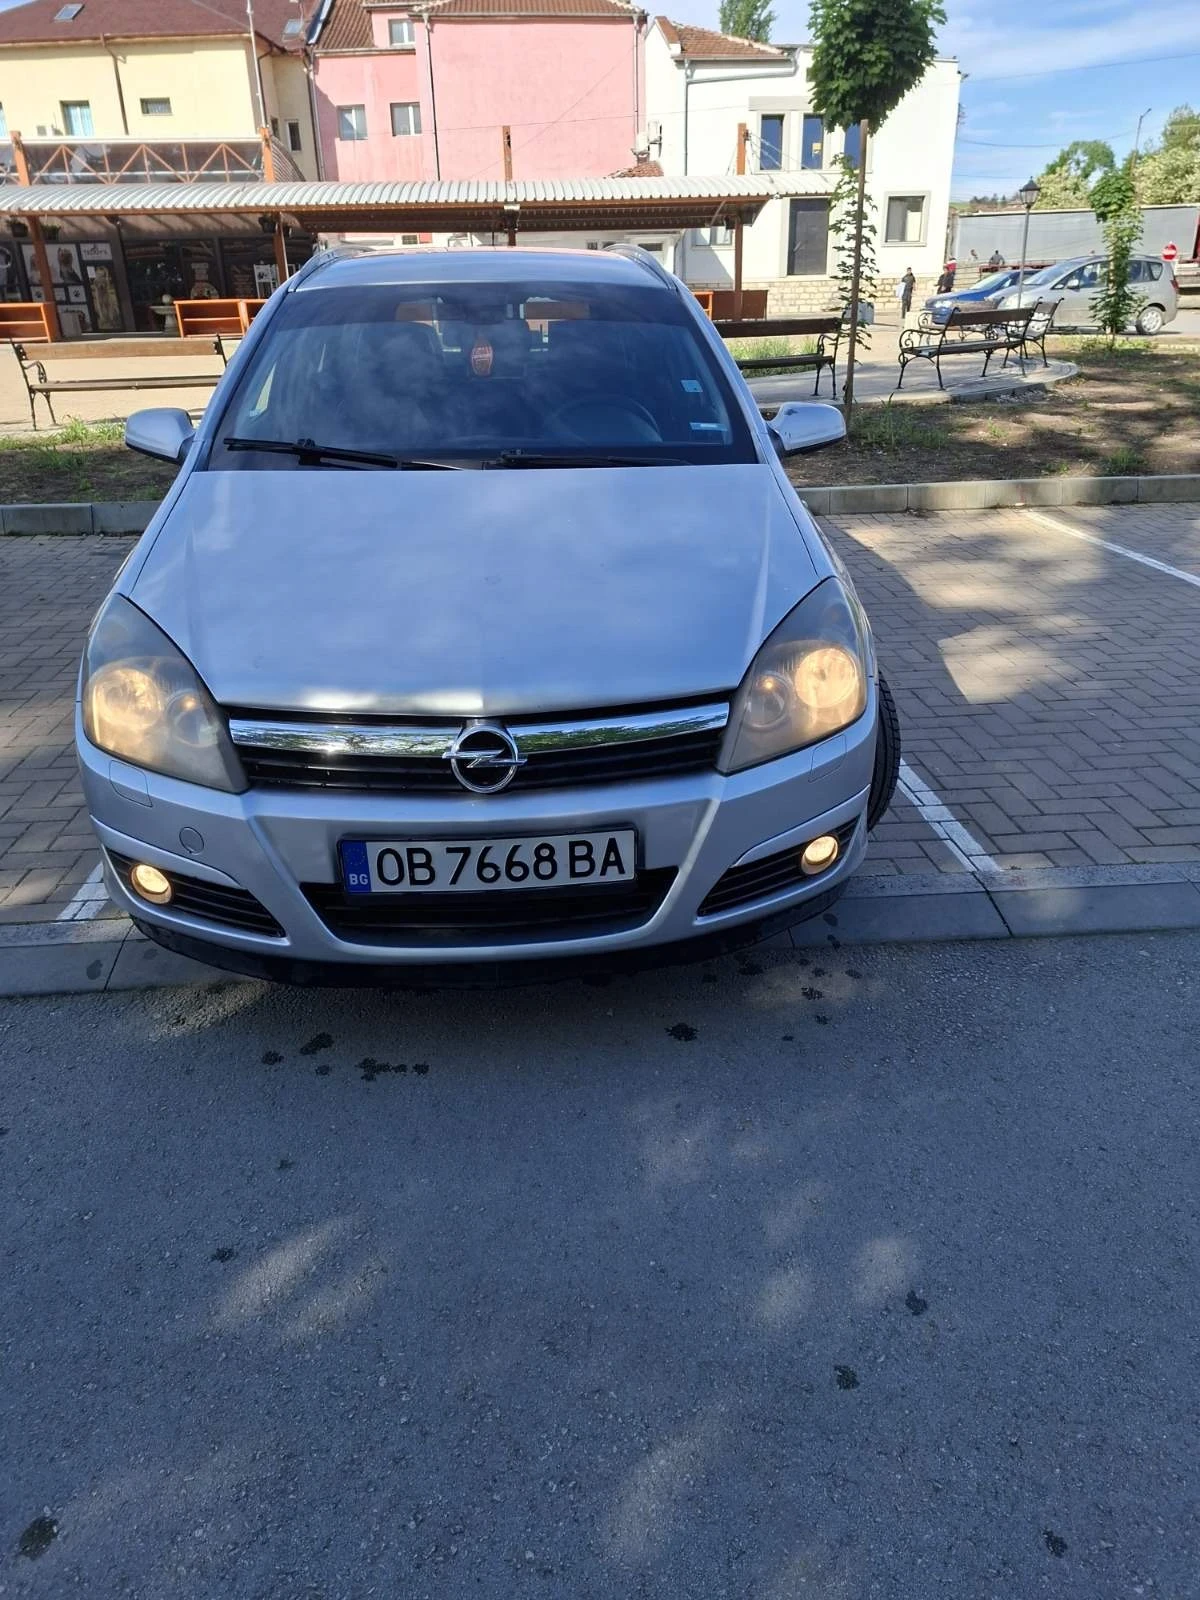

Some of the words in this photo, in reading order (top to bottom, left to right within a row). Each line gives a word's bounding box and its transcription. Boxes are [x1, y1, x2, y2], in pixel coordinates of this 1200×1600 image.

[376, 847, 436, 887] OB
[445, 842, 558, 886] 7668
[568, 837, 626, 879] BA
[349, 874, 369, 886] BG
